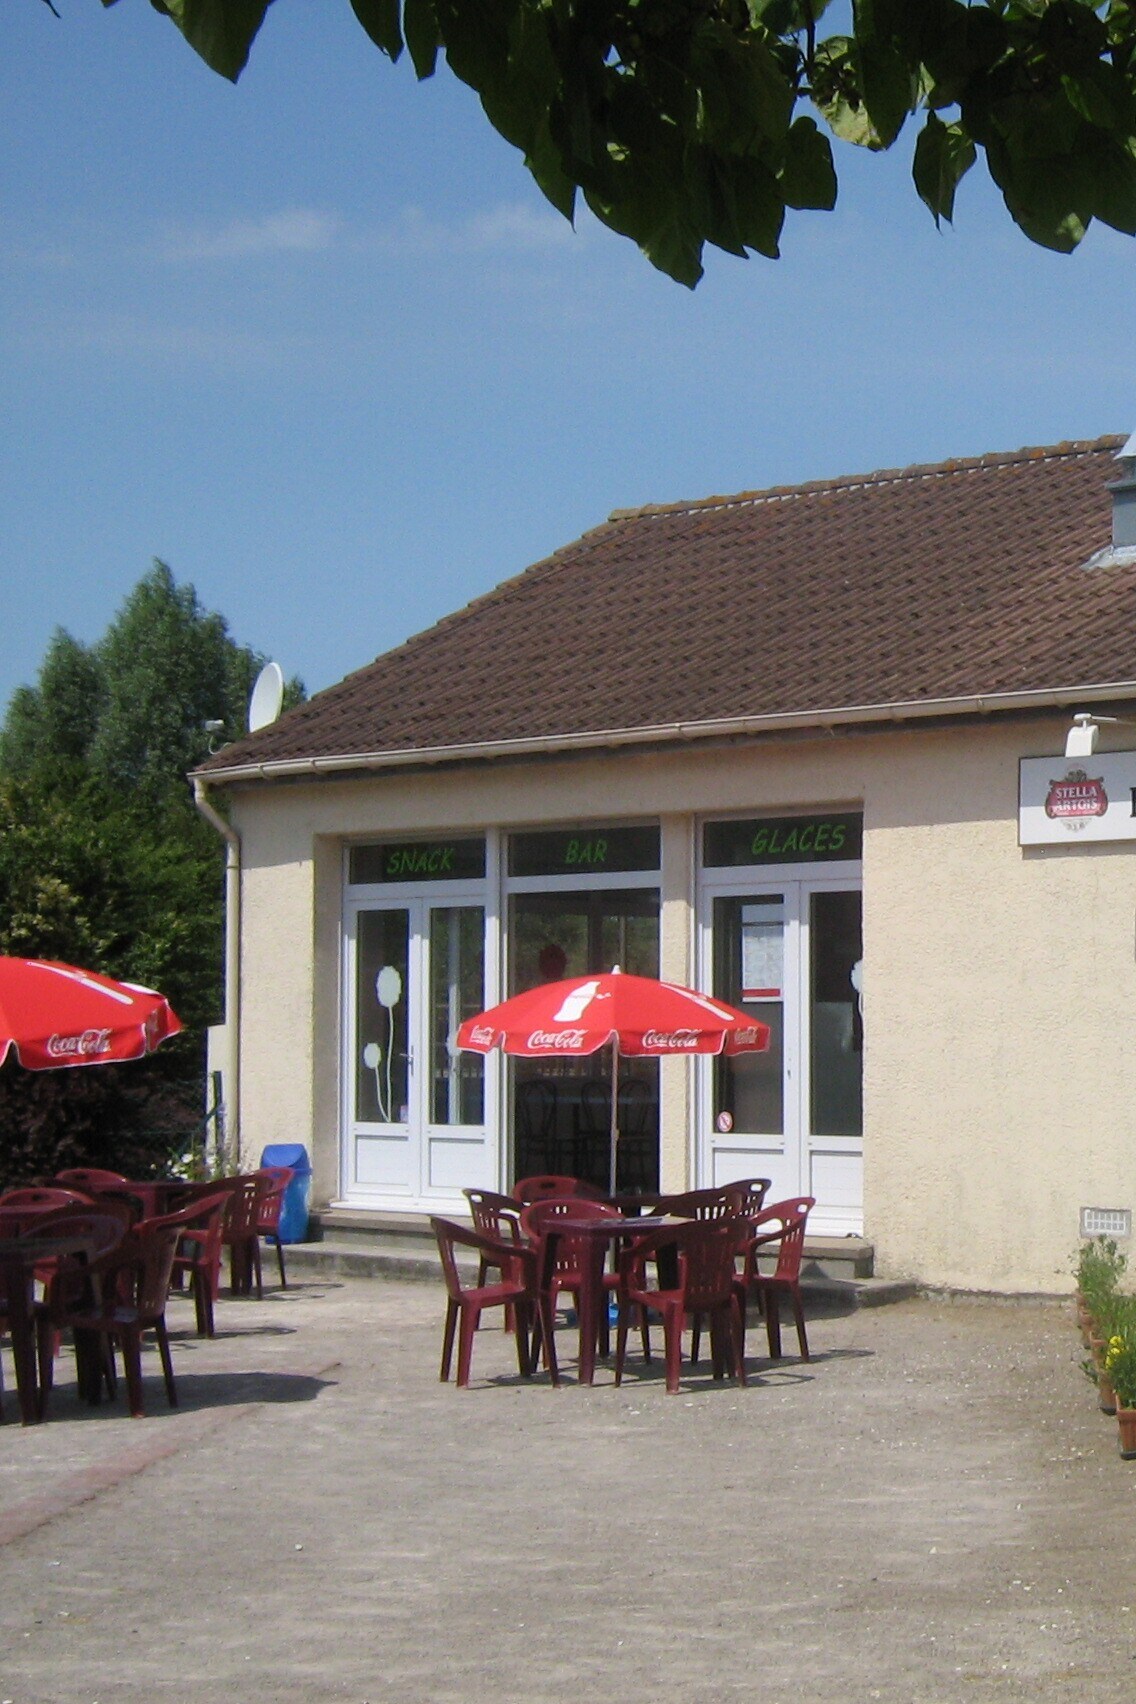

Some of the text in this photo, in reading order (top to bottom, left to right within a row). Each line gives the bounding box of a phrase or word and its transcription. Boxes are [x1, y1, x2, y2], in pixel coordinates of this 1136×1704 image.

[1056, 786, 1098, 798] STELLA
[1056, 798, 1098, 811] ARTOIS
[751, 824, 847, 855] GLACES
[386, 847, 455, 875] SNACK
[564, 839, 608, 865] BAR
[527, 1029, 589, 1049] Coca-Cola
[642, 1028, 702, 1049] Coca-Cola
